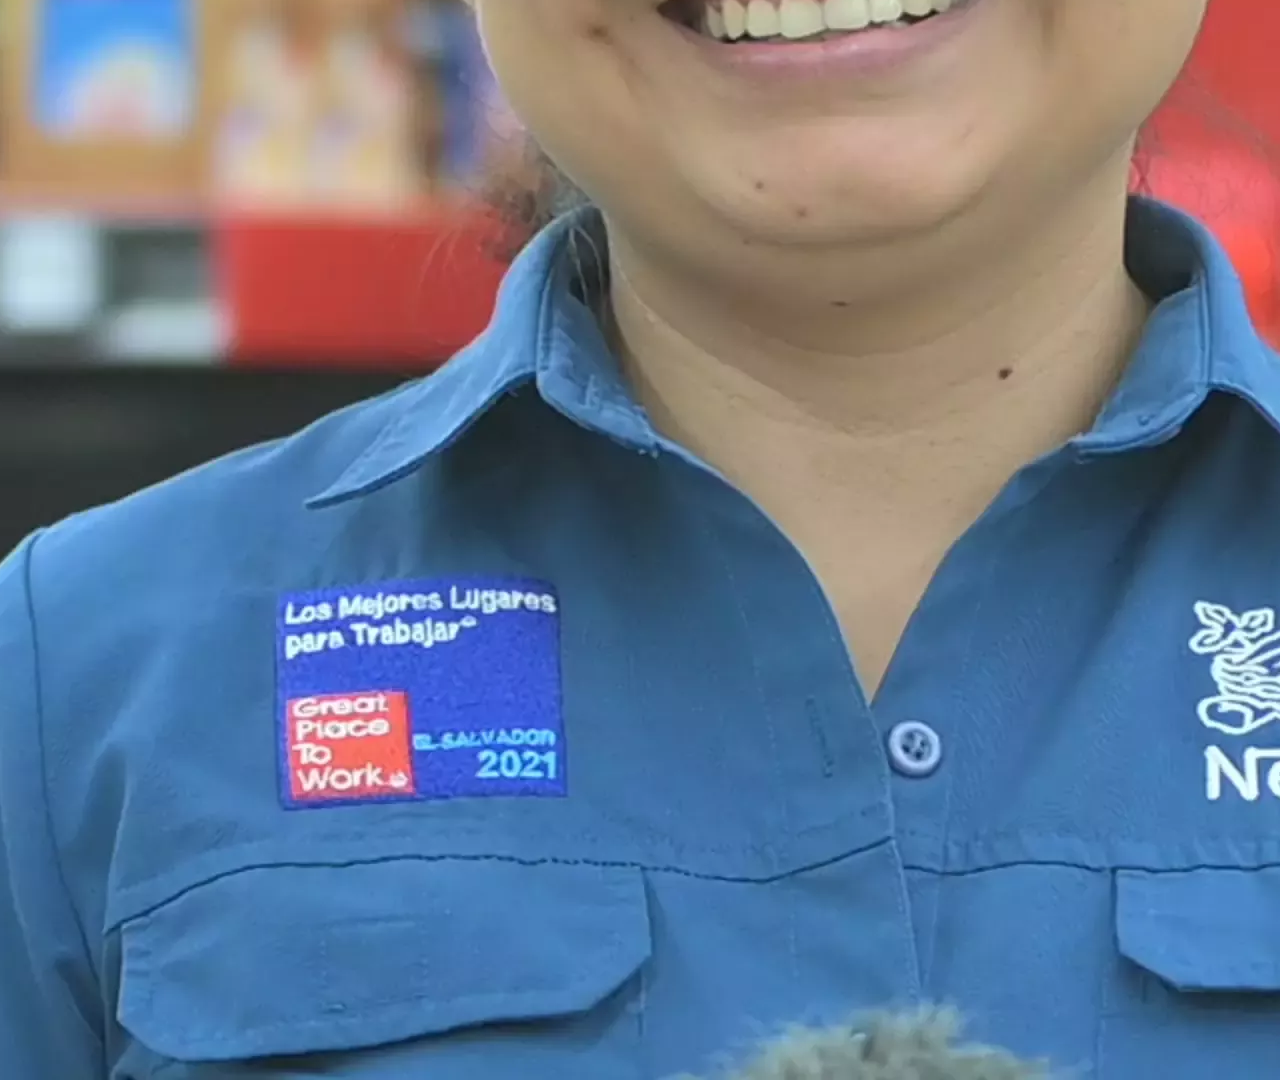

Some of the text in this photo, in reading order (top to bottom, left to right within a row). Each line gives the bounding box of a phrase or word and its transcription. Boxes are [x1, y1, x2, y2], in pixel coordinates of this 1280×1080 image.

[285, 585, 557, 624] Los Mejores Lugares
[285, 630, 346, 660] para
[292, 693, 389, 717] Great
[296, 719, 390, 740] Place
[475, 749, 557, 779] 2021
